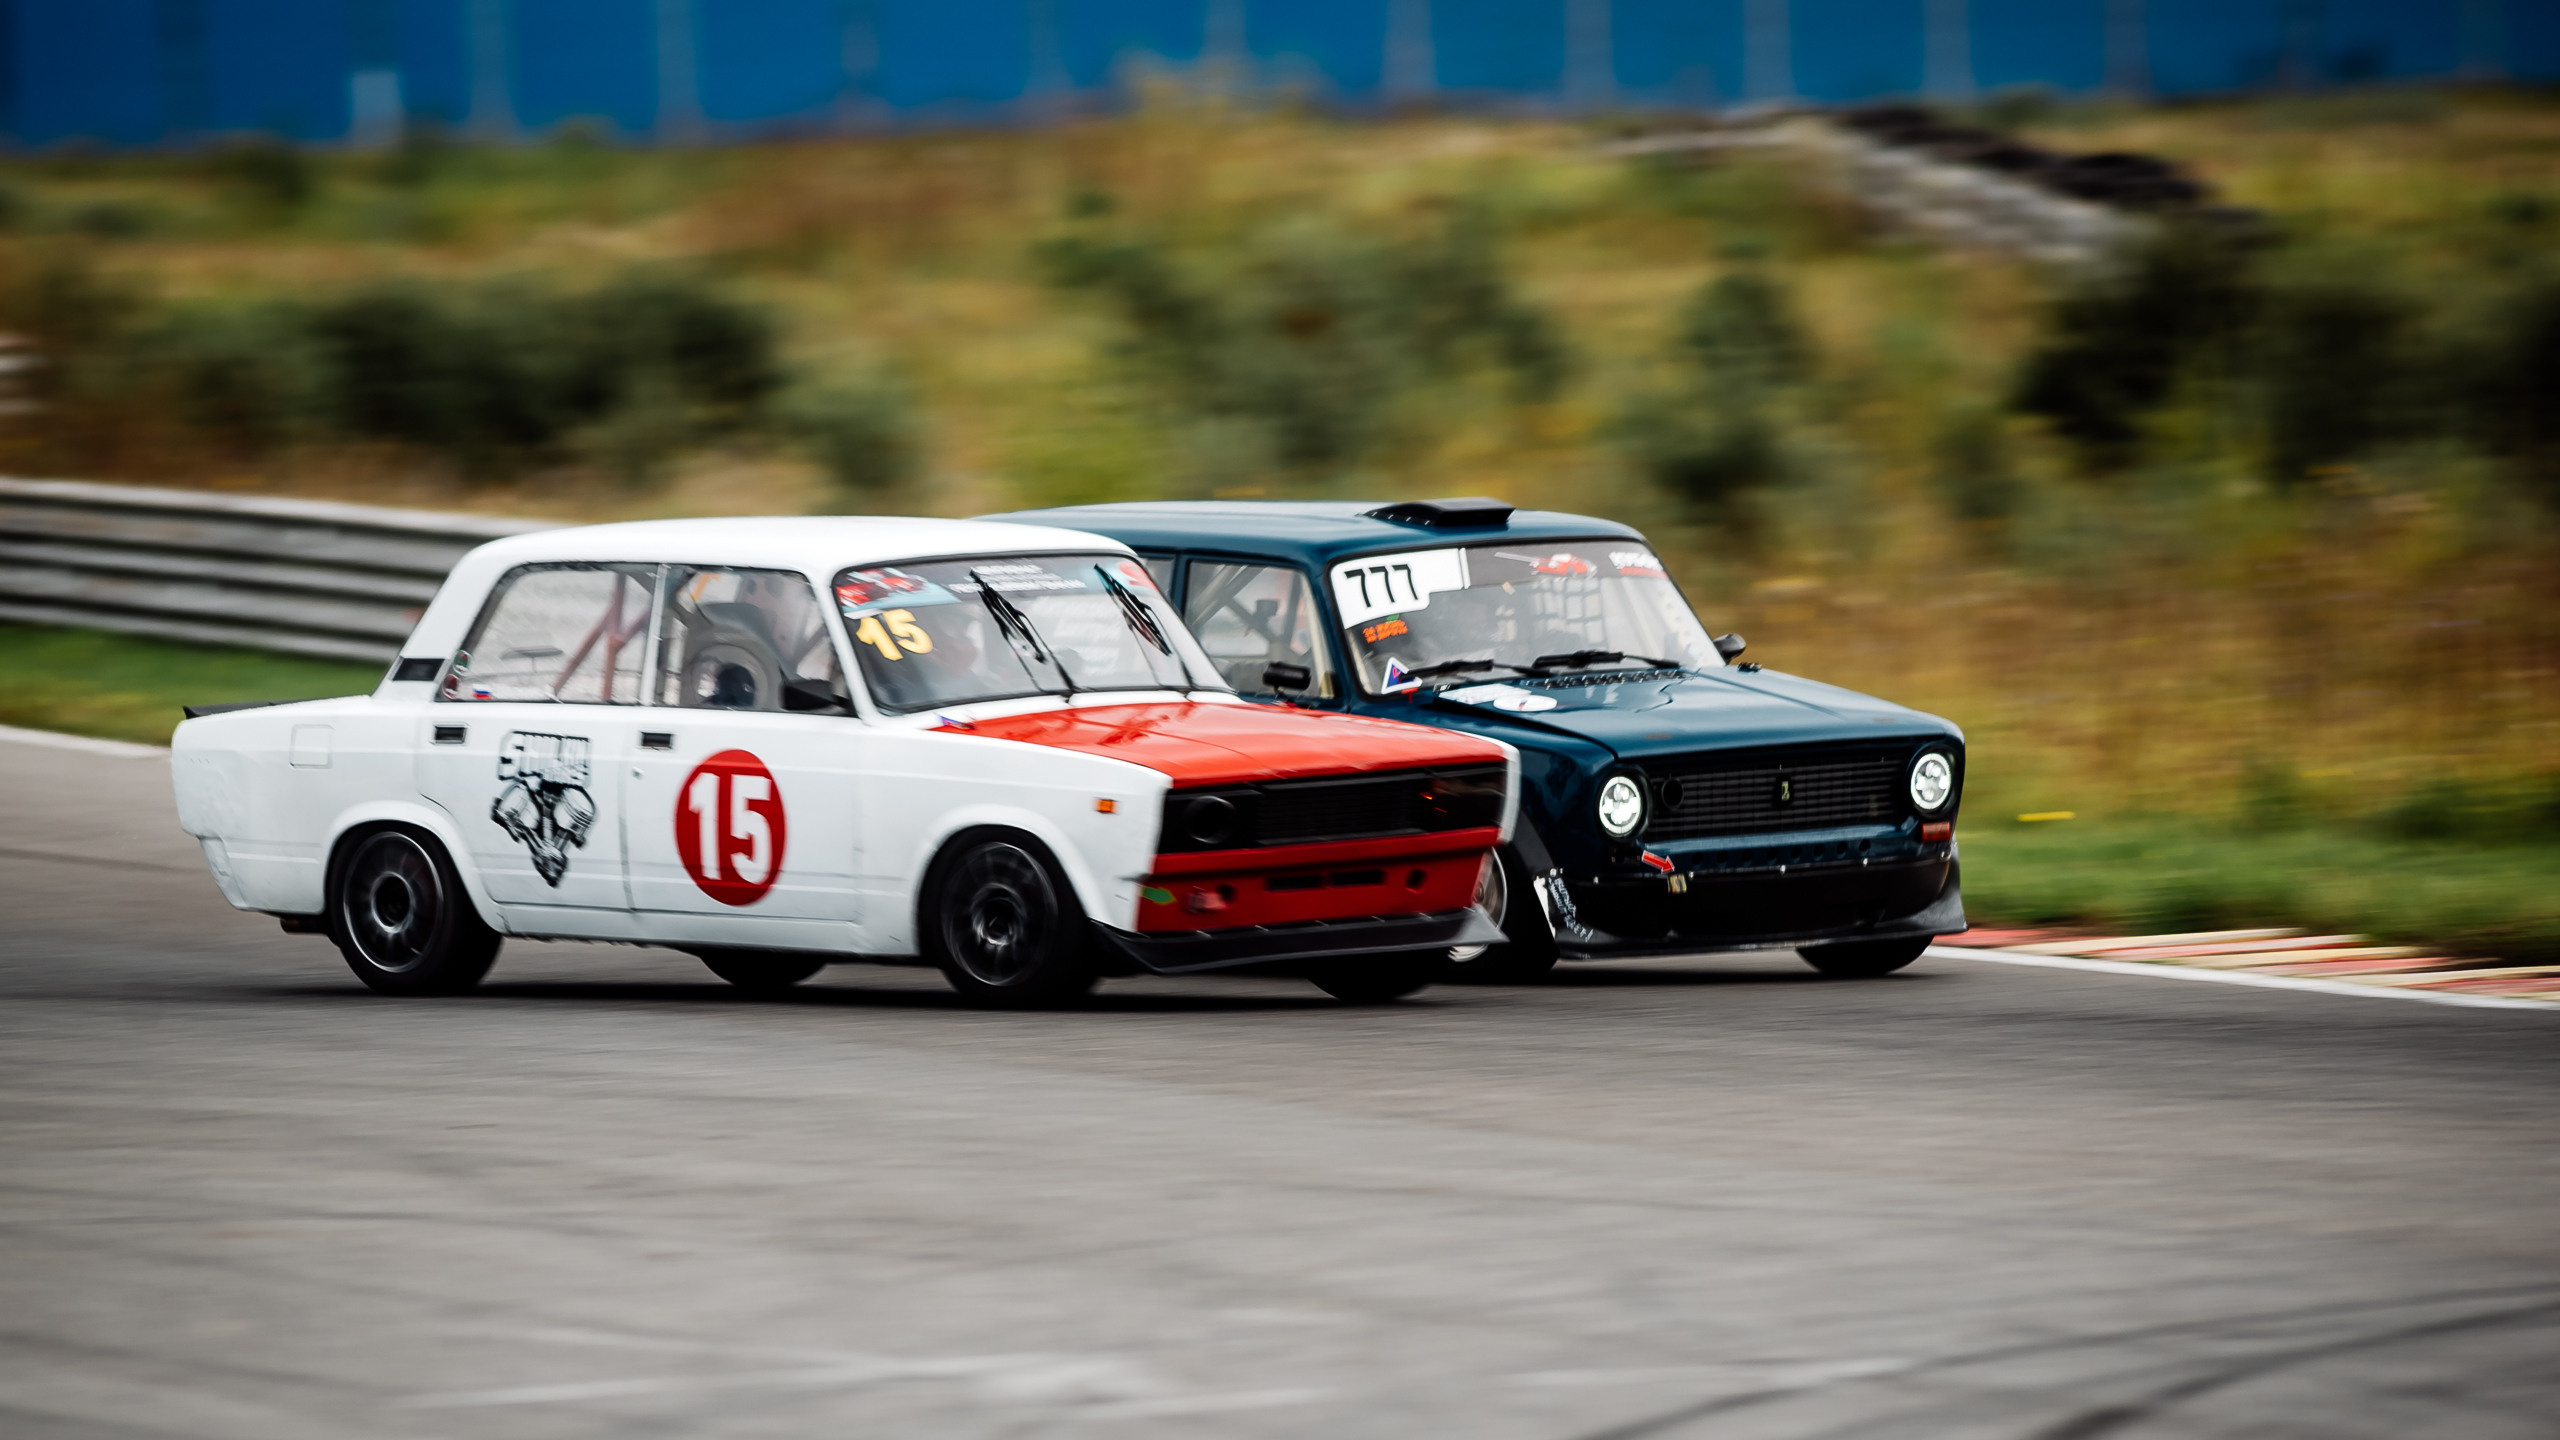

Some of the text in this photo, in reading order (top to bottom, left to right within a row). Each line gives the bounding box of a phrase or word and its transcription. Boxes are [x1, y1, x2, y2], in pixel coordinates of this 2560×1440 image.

[1344, 564, 1419, 608] 777
[856, 608, 934, 661] 15
[688, 772, 773, 885] 15
